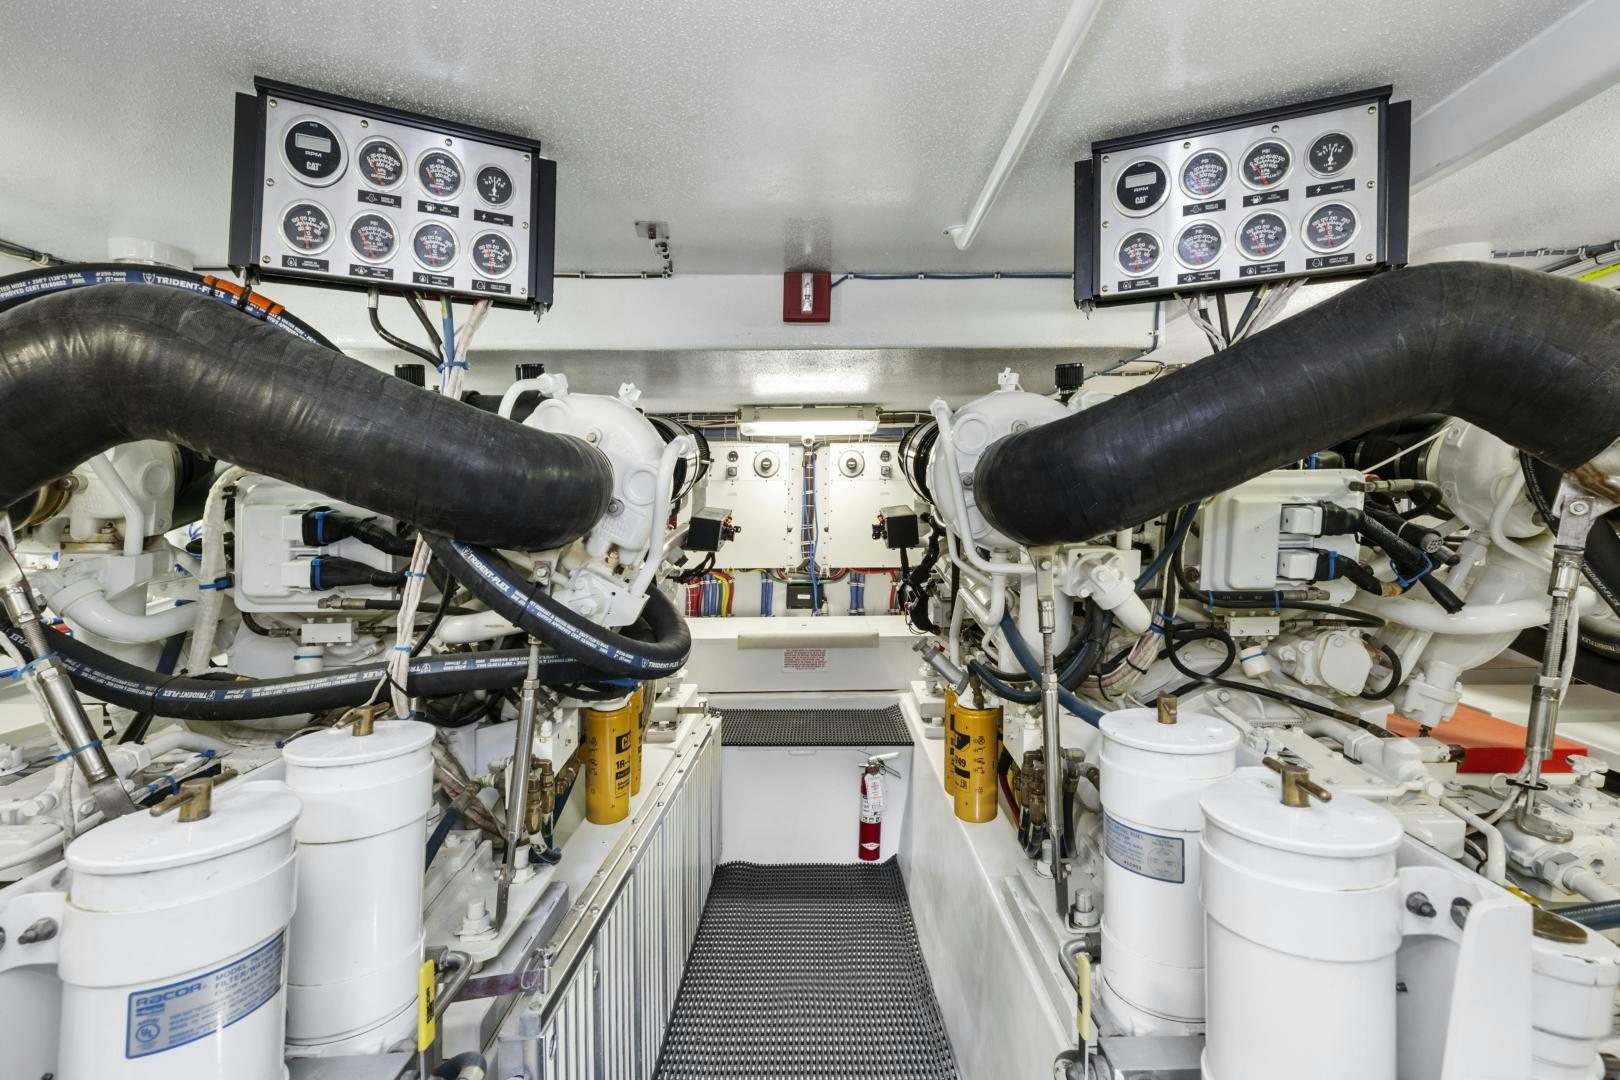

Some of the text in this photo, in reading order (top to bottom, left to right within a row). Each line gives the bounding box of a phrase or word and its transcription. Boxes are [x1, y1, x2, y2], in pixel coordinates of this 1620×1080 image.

[306, 161, 319, 171] CAT
[1135, 196, 1149, 205] CAT
[25, 284, 40, 293] CERT
[468, 553, 509, 592] TRIDENT-FLEX
[163, 690, 207, 699] TRIDENT-FLEX
[215, 963, 246, 981] MODEL
